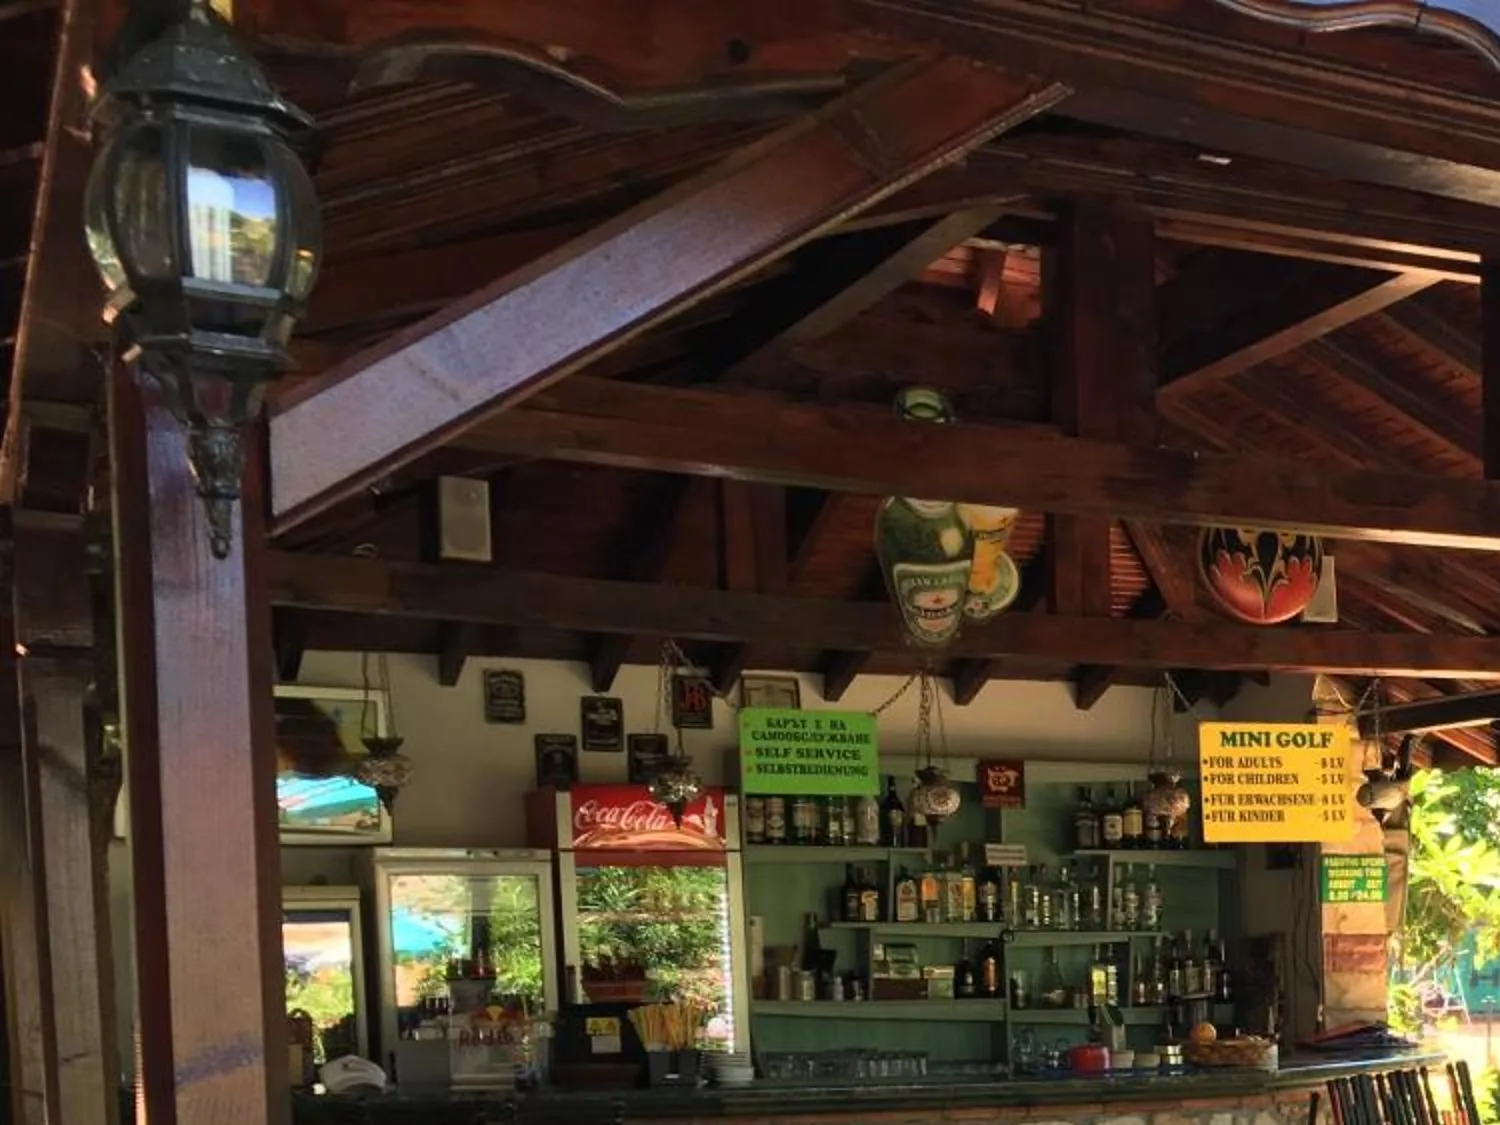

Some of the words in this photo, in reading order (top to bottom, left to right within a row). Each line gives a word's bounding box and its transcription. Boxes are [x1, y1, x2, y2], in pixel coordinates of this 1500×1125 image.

[1220, 731, 1272, 748] MINI
[1276, 731, 1334, 749] GOLF
[755, 747, 792, 758] SELF
[796, 747, 861, 760] SERVICE
[1209, 756, 1233, 768] FOR
[1238, 756, 1283, 768] ADULTS
[1210, 773, 1235, 785] FOR
[1237, 773, 1299, 785] CHILDREN
[1239, 810, 1285, 822] KINDER
